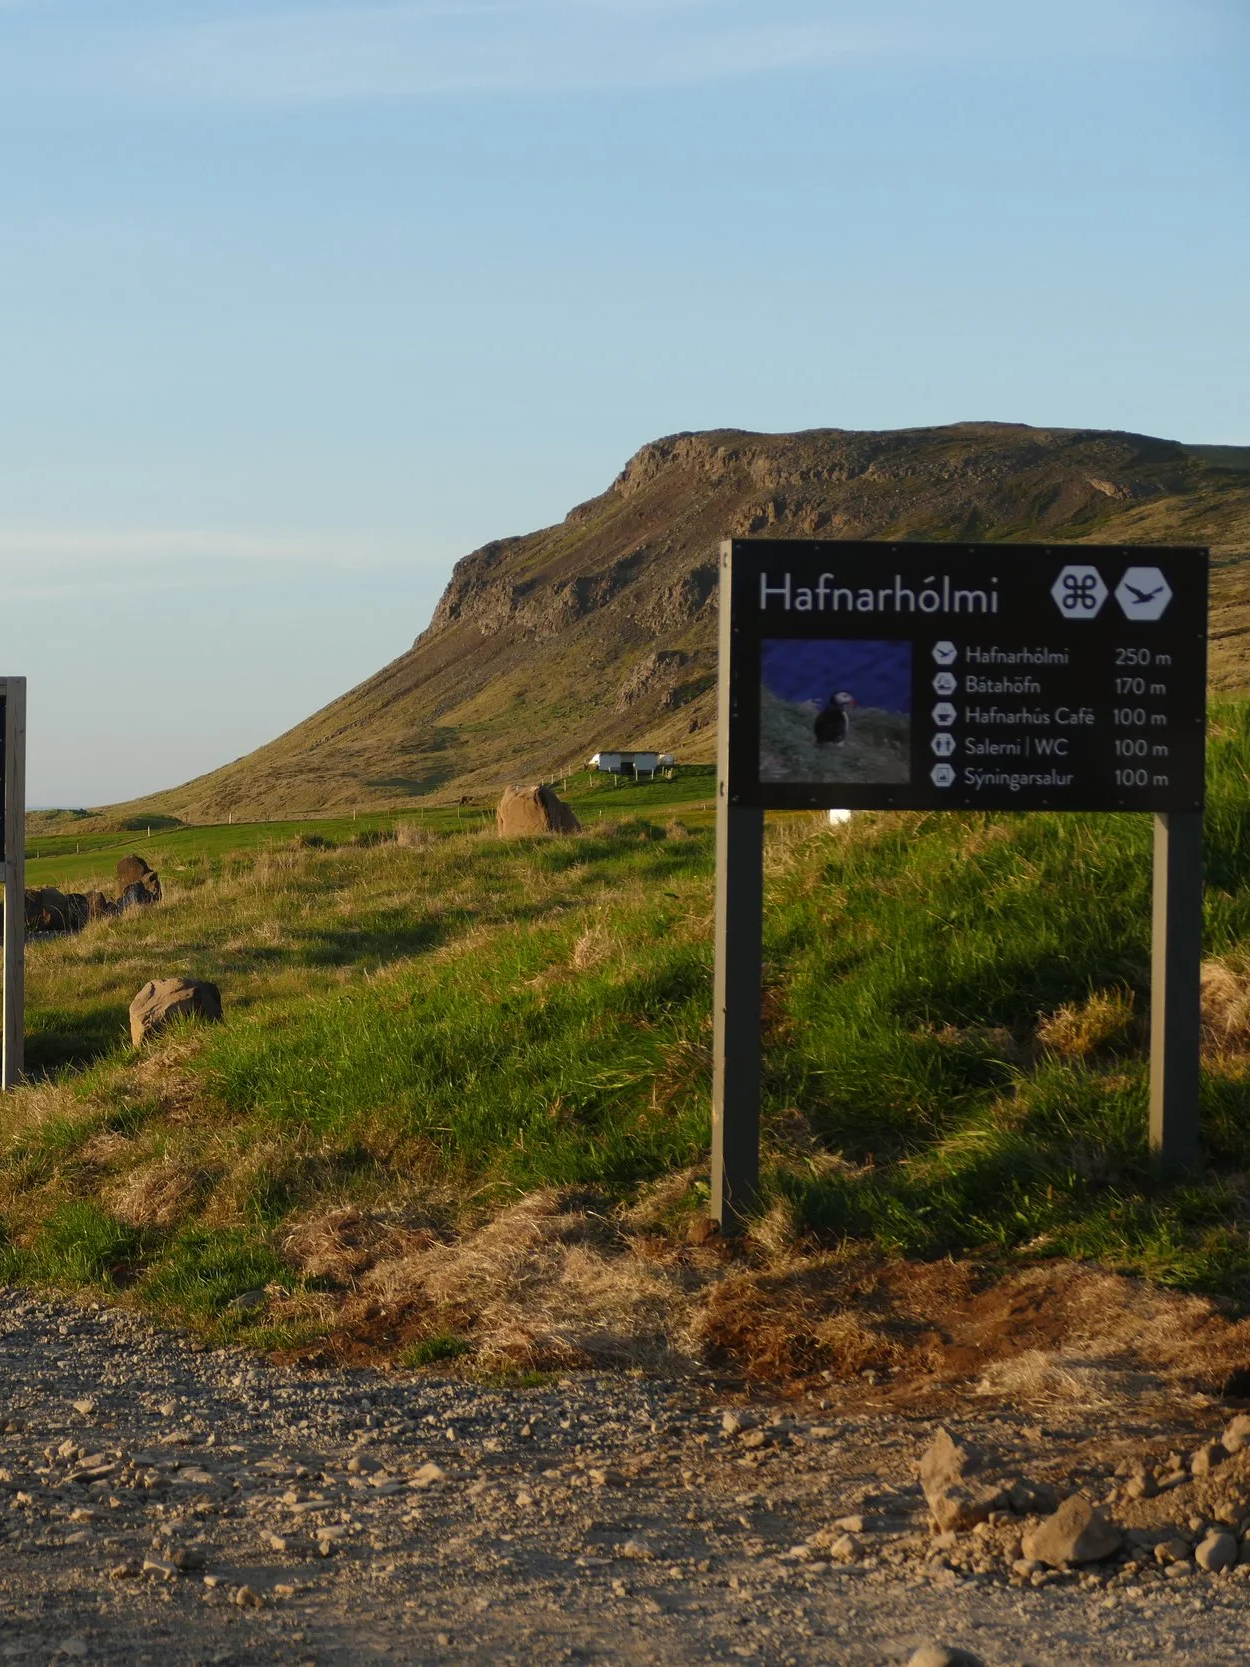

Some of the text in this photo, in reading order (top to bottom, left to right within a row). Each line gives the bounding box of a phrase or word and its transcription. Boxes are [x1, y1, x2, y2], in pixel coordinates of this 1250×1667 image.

[759, 572, 999, 613] Hafnarhólmi
[965, 646, 1172, 665] Hafnarhólmi 250 m
[965, 675, 1167, 695] Bátahöfn 170 m
[965, 706, 1167, 726] Hafnarhús Café 100 m
[965, 737, 1021, 755] Salerni
[1035, 738, 1069, 756] WC
[1114, 739, 1148, 757] 100
[1152, 746, 1169, 757] m
[964, 767, 1169, 791] Sýningarsalur 100 m
